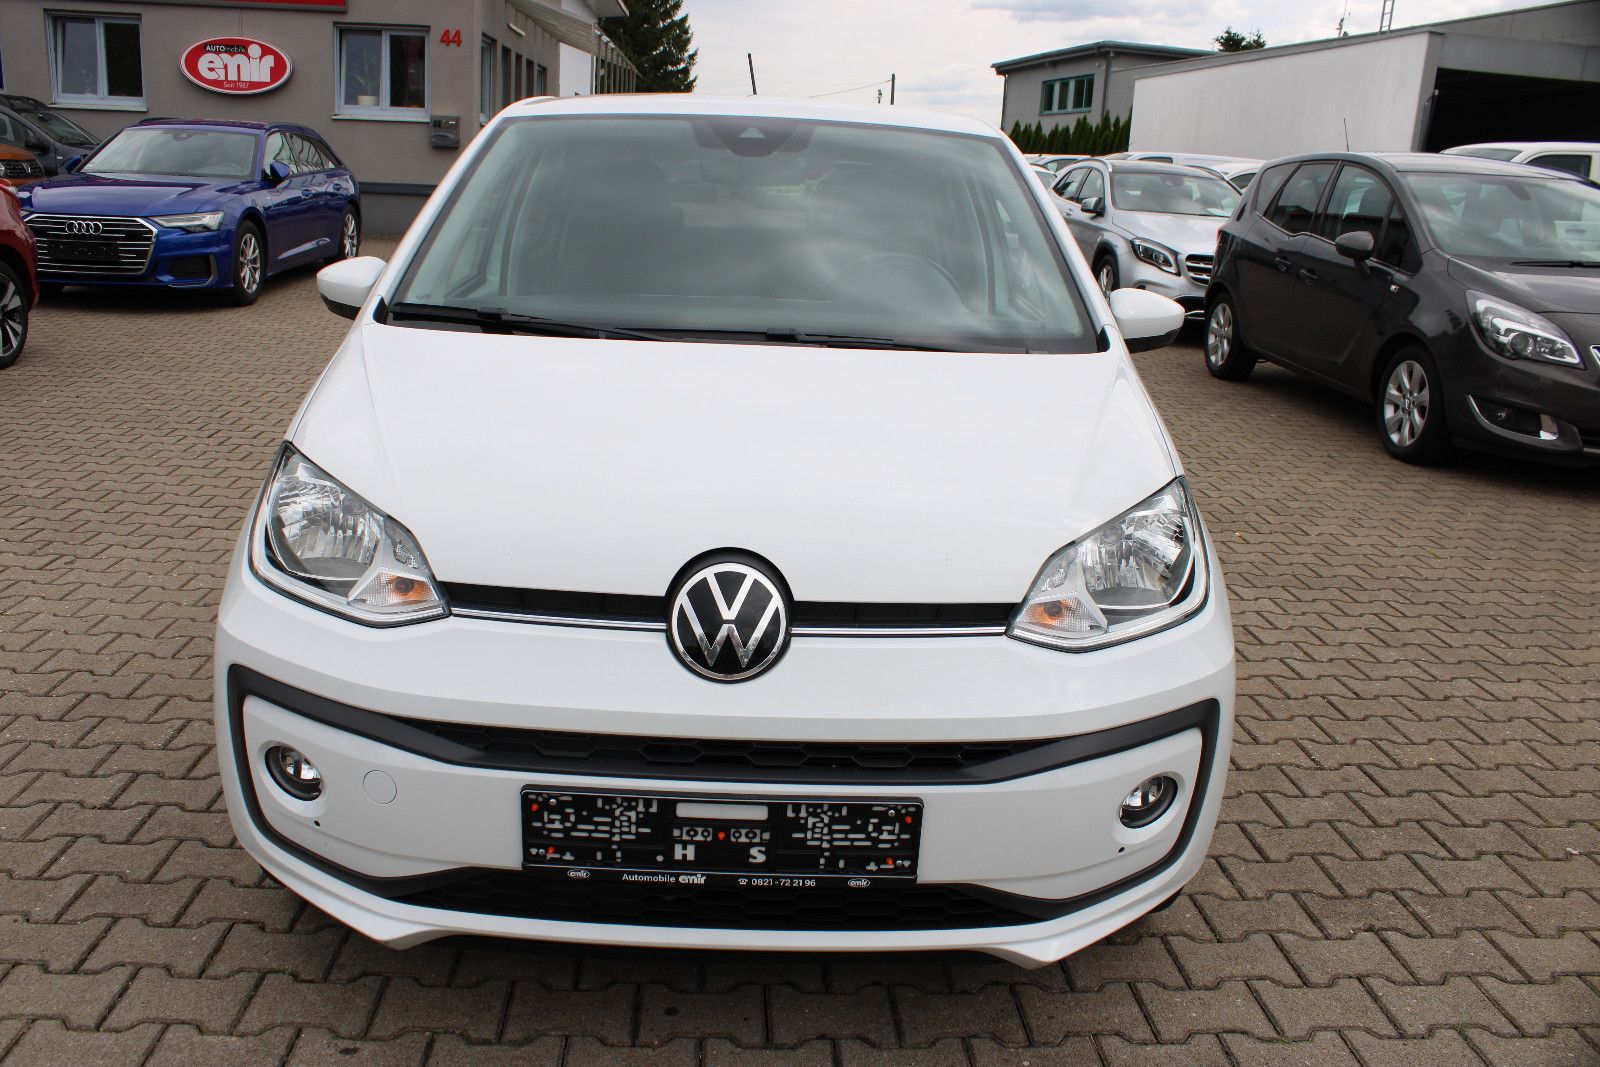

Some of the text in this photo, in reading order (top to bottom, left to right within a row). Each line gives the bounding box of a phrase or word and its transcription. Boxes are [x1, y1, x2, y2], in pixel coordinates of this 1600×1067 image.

[440, 28, 462, 47] 44
[197, 43, 275, 82] emir
[621, 873, 676, 883] Automobile
[678, 873, 706, 884] emir
